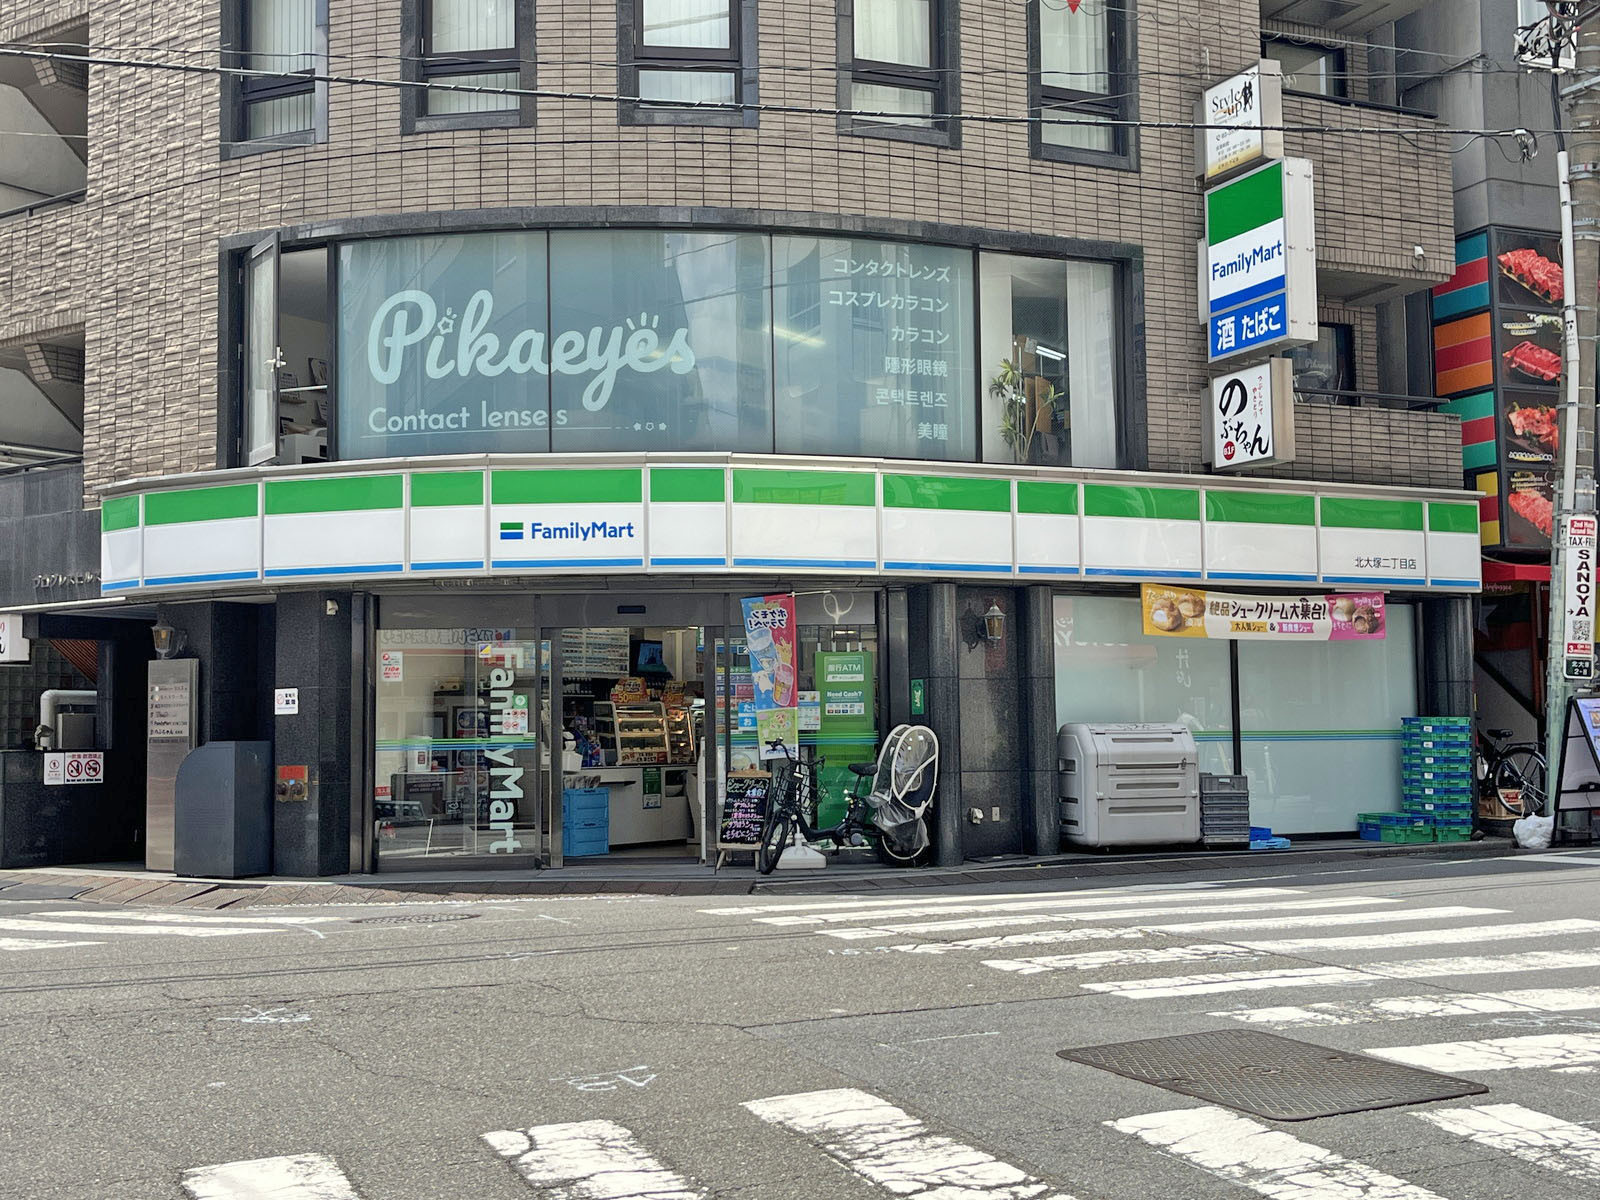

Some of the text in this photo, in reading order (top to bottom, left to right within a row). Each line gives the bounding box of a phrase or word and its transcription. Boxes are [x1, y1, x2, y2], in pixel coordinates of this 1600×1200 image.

[1212, 88, 1241, 113] Style
[834, 258, 950, 282] コンタクトレンズ
[1212, 240, 1282, 281] FamilyMart
[829, 290, 949, 313] コスプレカラコン
[892, 326, 950, 344] カラコン
[1217, 305, 1281, 350] 酒 たばこ
[367, 289, 696, 411] Pikaeyes
[875, 387, 948, 408] 콘택트렌즈
[368, 400, 568, 433] Contact lenses
[918, 423, 948, 440] 美瞳
[1224, 446, 1235, 456] B1F
[531, 522, 634, 541] FamilyMart
[1355, 556, 1417, 570] 北大塚二丁目店
[1576, 550, 1590, 617] SANOYA
[1269, 622, 1276, 631] &
